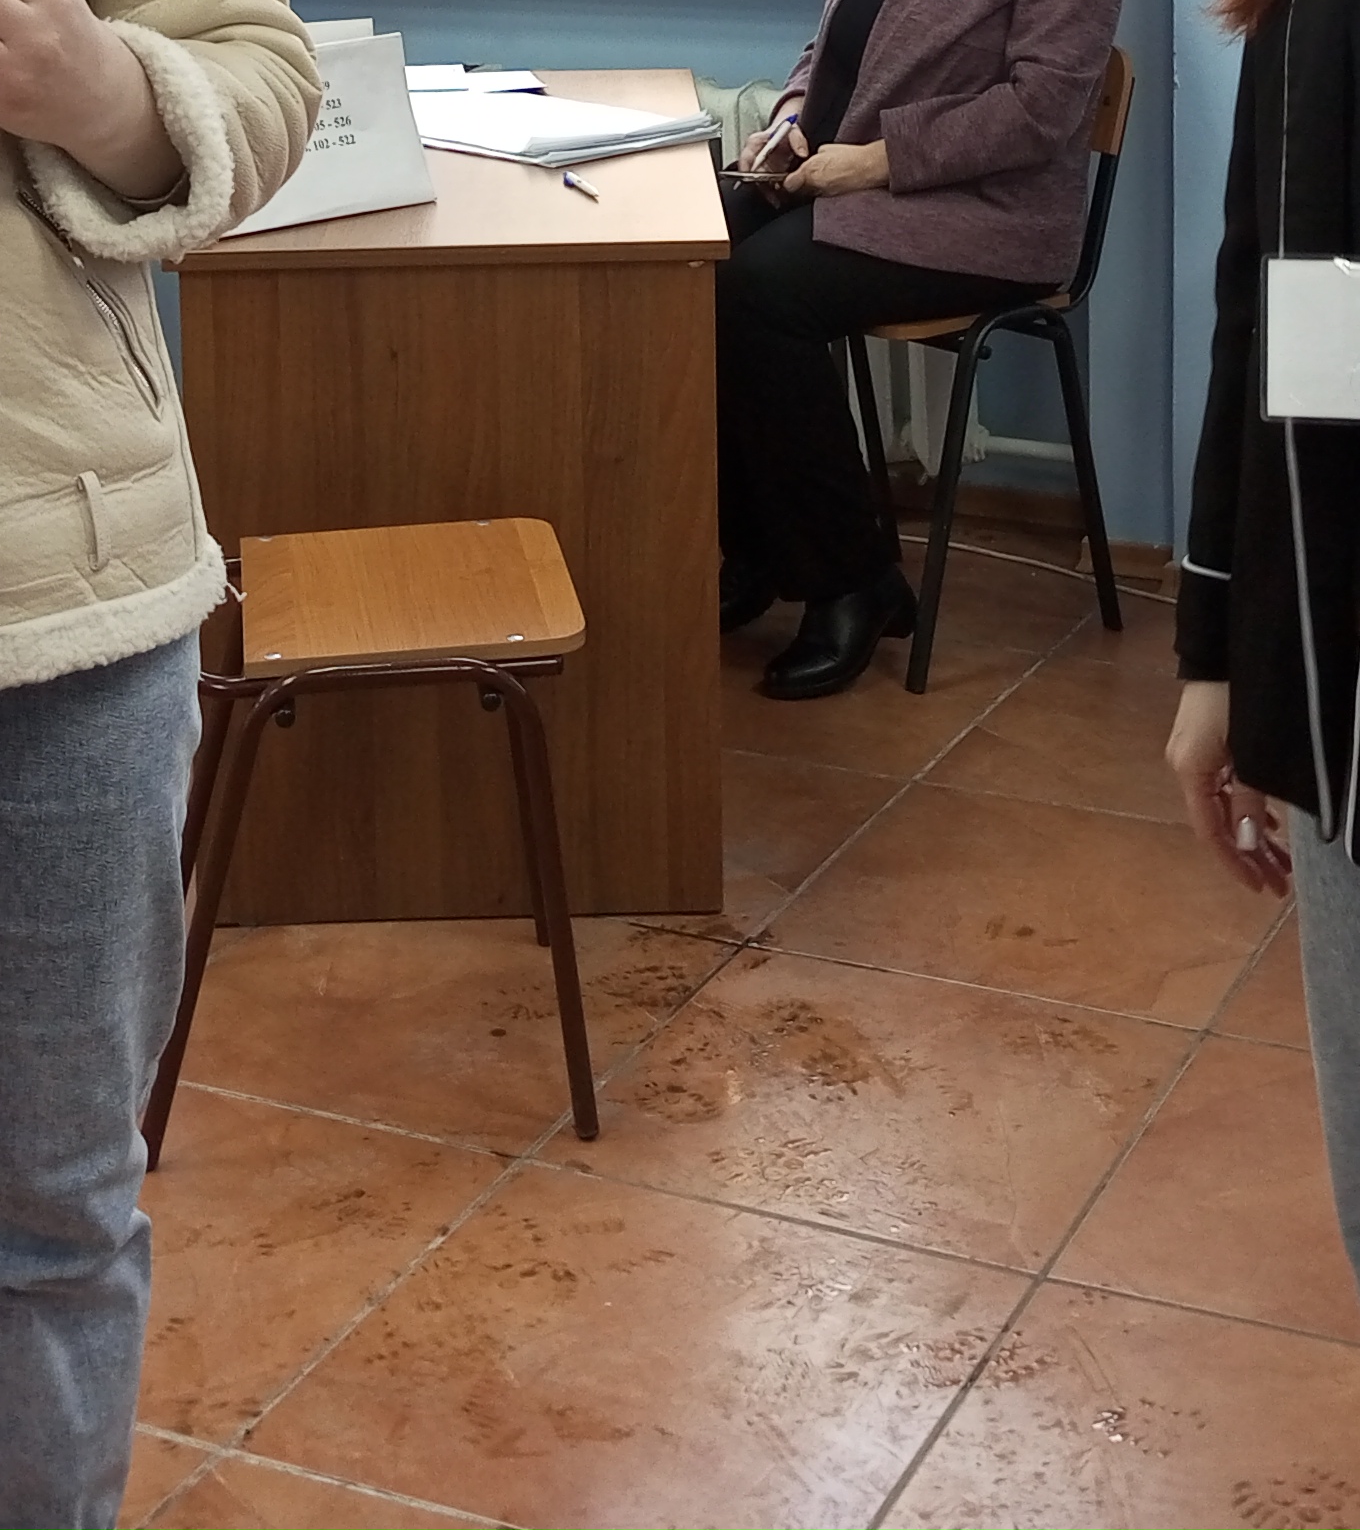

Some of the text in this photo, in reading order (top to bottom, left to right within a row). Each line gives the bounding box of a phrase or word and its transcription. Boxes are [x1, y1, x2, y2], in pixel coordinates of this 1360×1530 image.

[325, 98, 342, 110] 523
[334, 115, 352, 128] 526
[313, 138, 330, 151] 102
